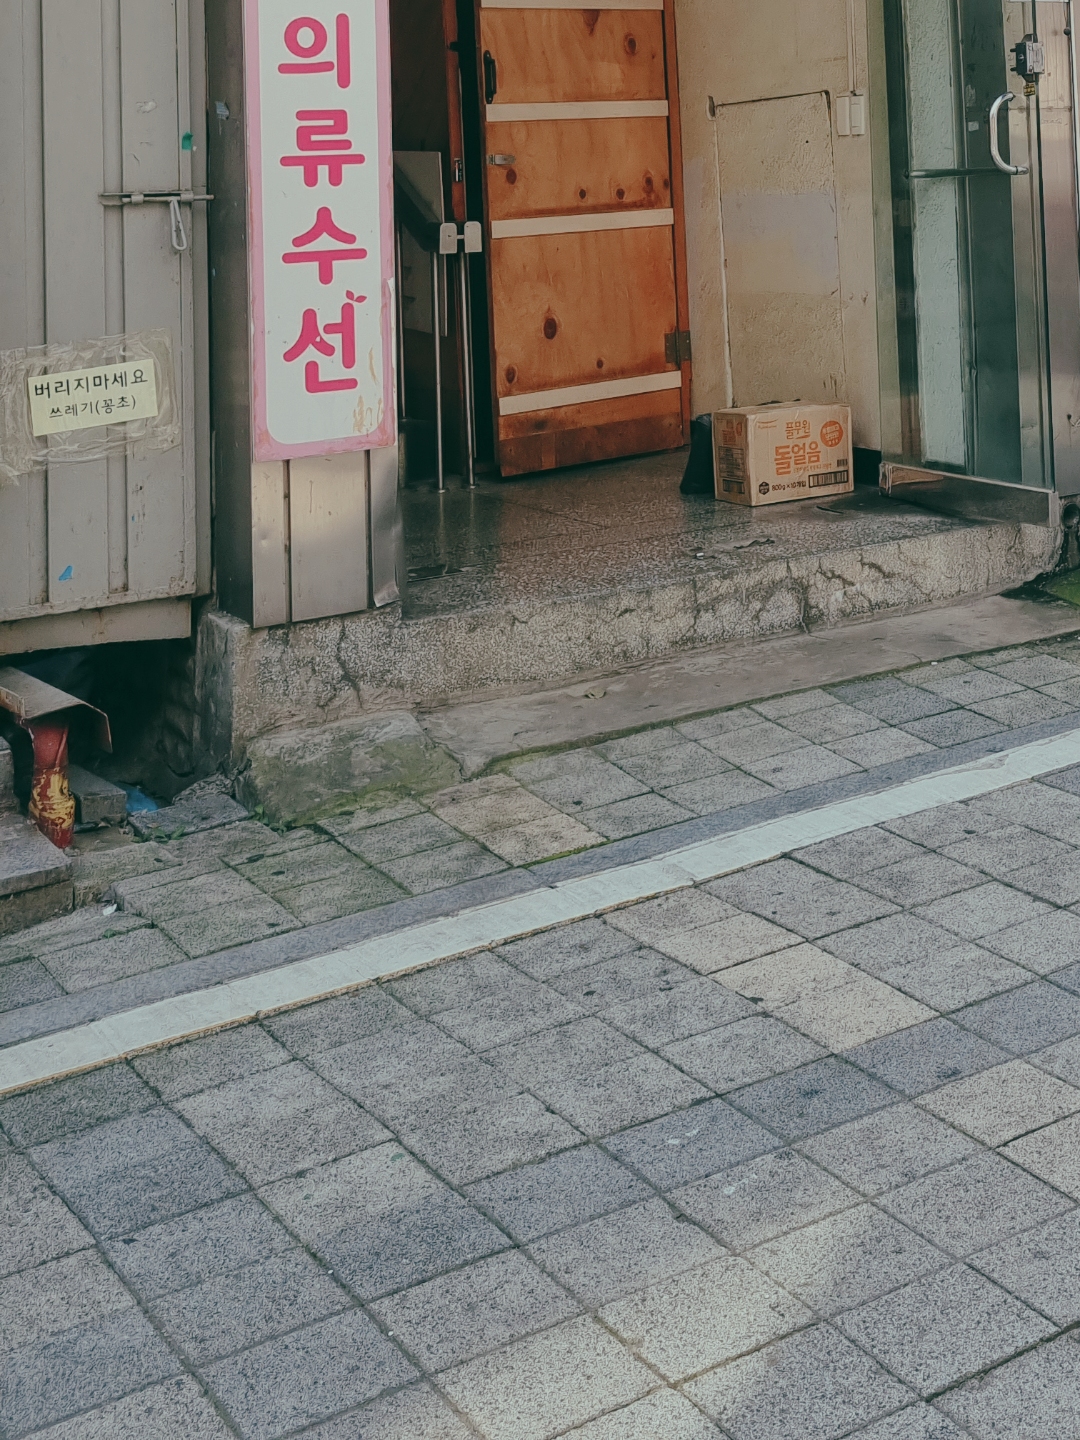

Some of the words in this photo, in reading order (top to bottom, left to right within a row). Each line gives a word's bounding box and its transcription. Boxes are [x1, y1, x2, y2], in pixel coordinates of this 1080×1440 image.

[34, 369, 148, 399] 버리지마세요
[48, 395, 137, 420] 쓰레기(꽁초)
[774, 440, 822, 476] 돌얼음
